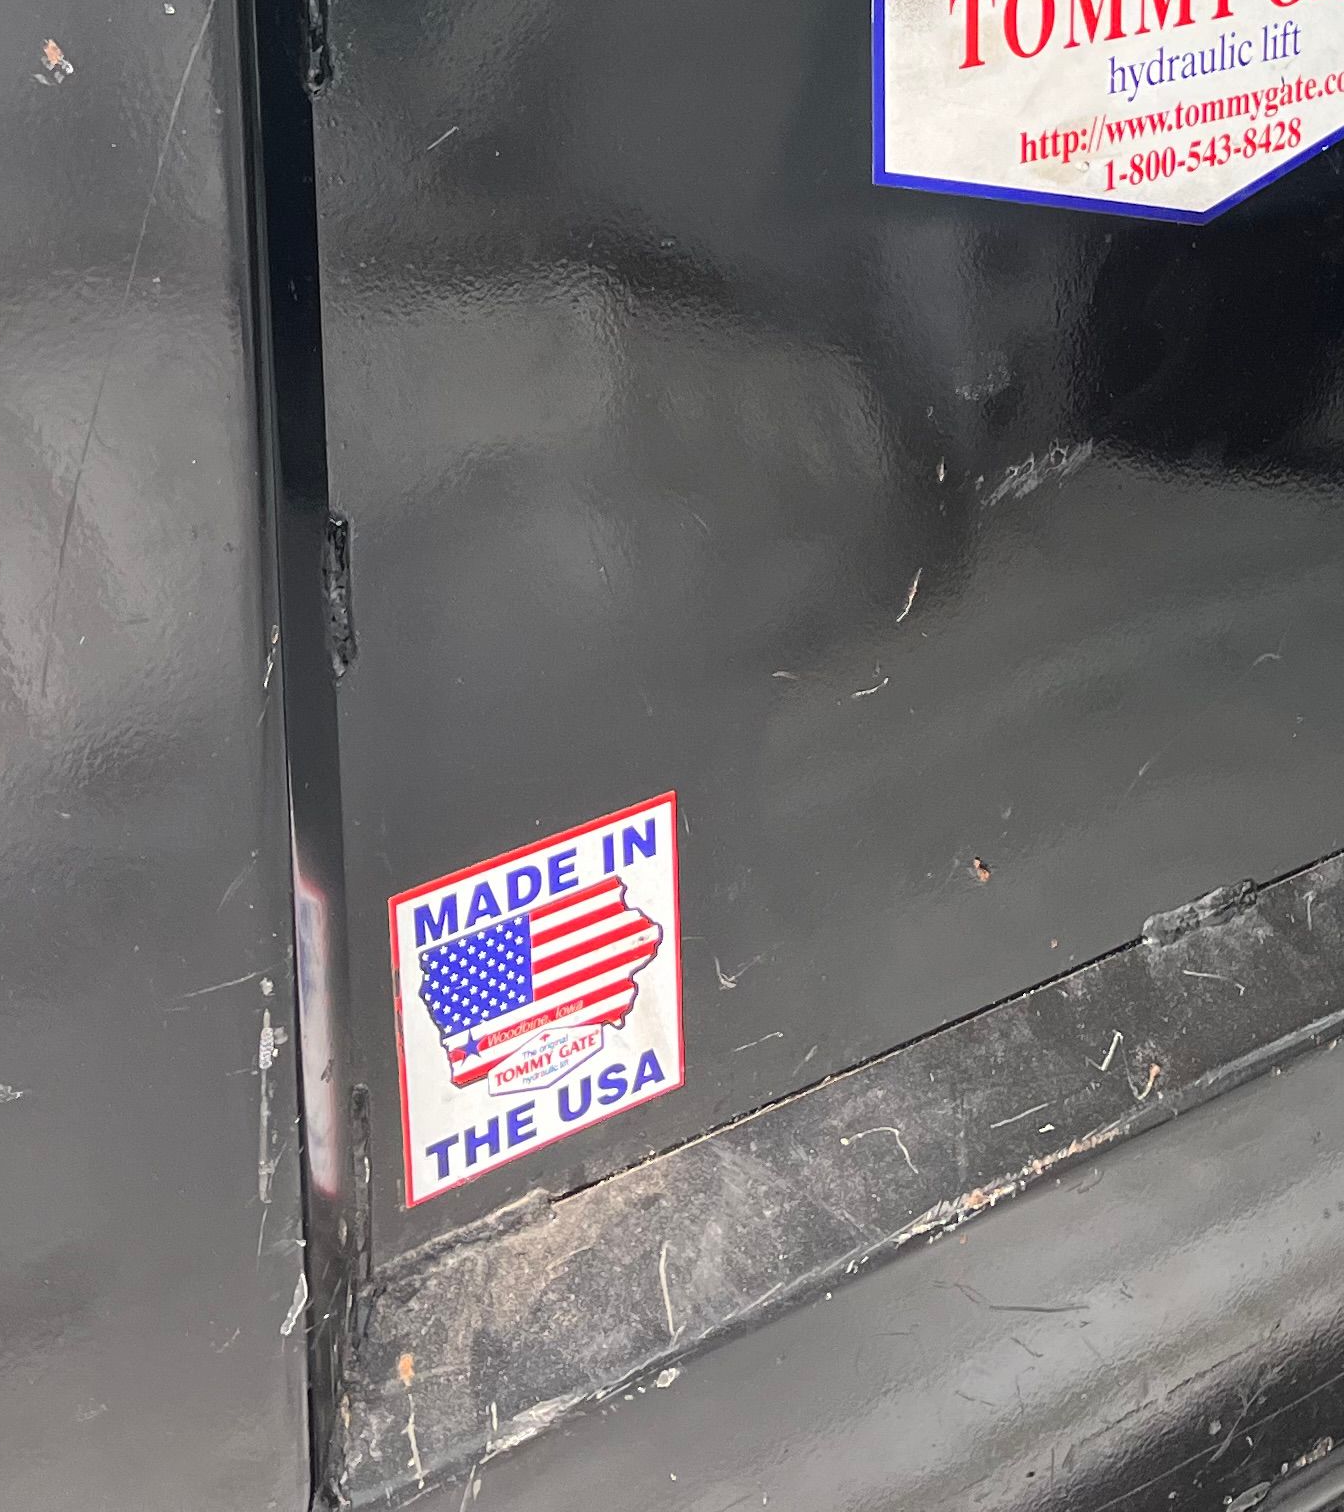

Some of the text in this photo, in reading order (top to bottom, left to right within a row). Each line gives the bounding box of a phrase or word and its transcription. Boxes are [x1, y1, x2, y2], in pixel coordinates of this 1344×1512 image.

[1108, 20, 1302, 102] hydraulic lift
[1104, 118, 1302, 191] 1-800-543-8428
[414, 818, 656, 948] MADE IN
[495, 1051, 553, 1087] TOMMY
[425, 1048, 666, 1180] THE USA
